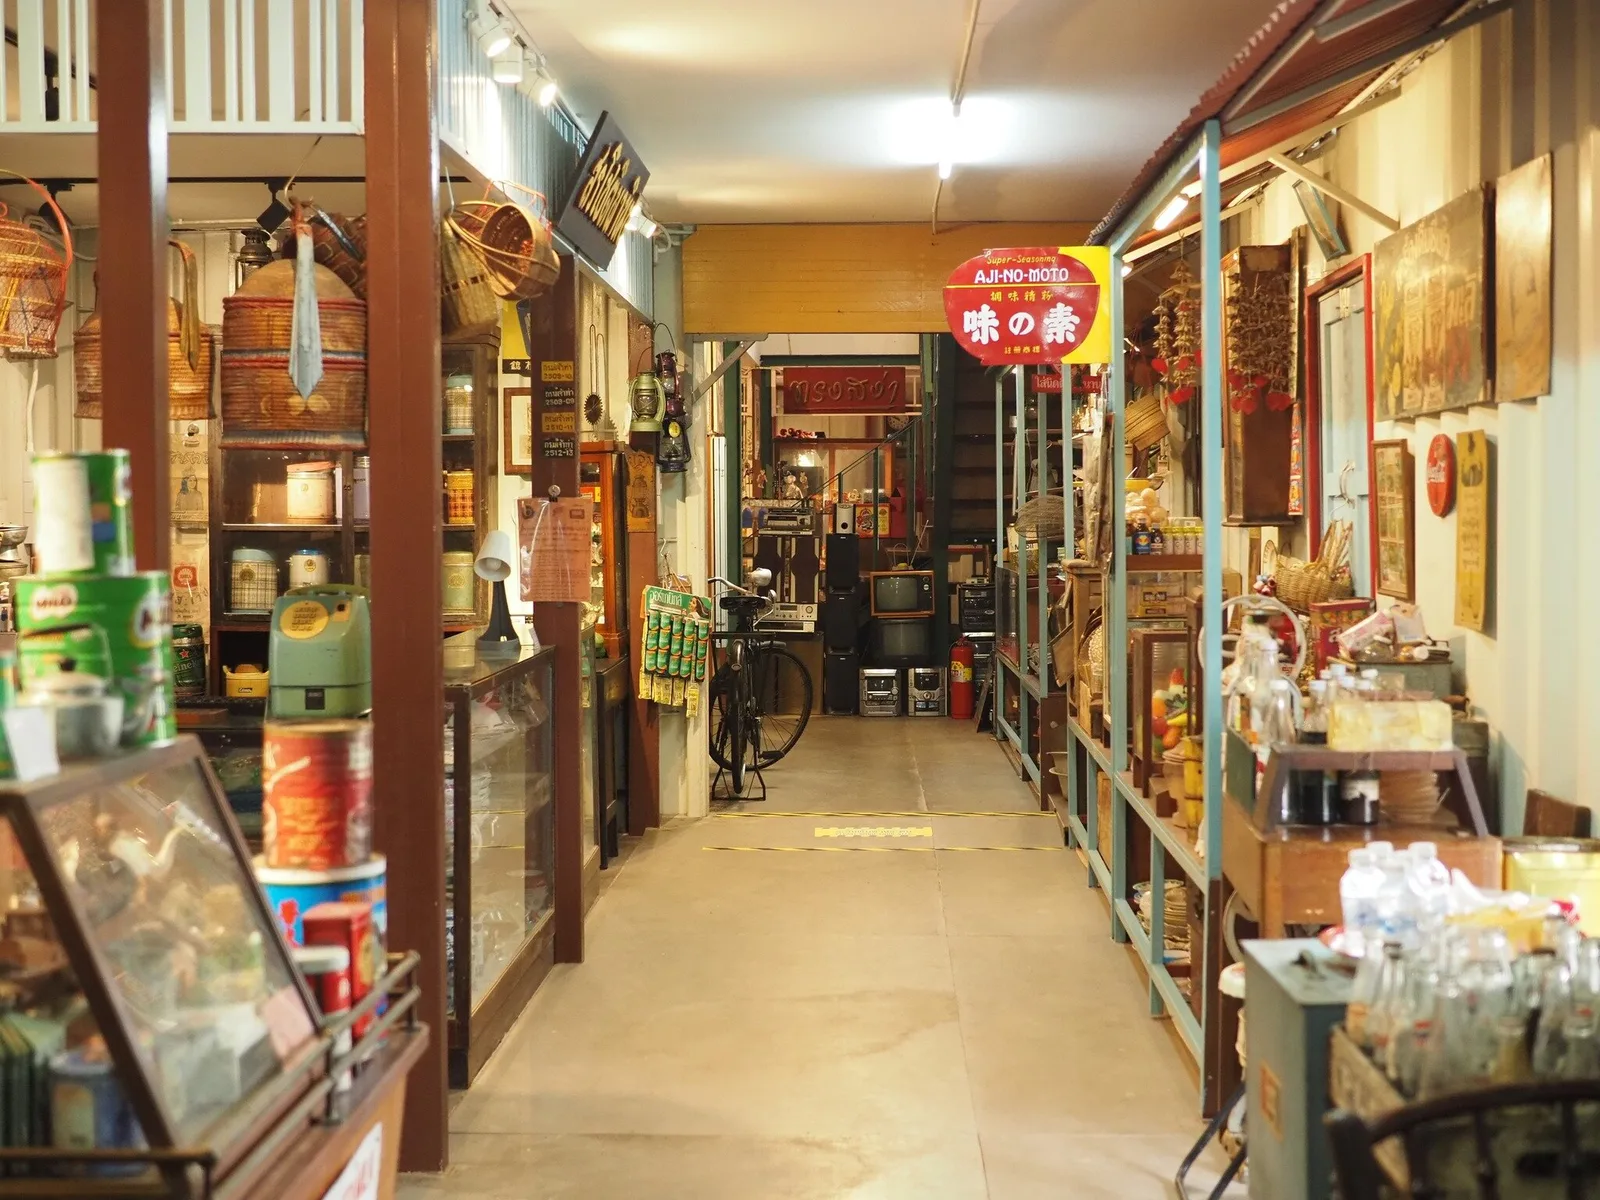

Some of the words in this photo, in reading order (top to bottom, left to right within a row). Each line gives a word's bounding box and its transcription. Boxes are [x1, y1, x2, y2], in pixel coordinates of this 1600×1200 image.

[986, 254, 1057, 265] Super-Seasoning
[974, 267, 1070, 284] AJI-NO-MOTO
[963, 302, 1081, 346] 味の素
